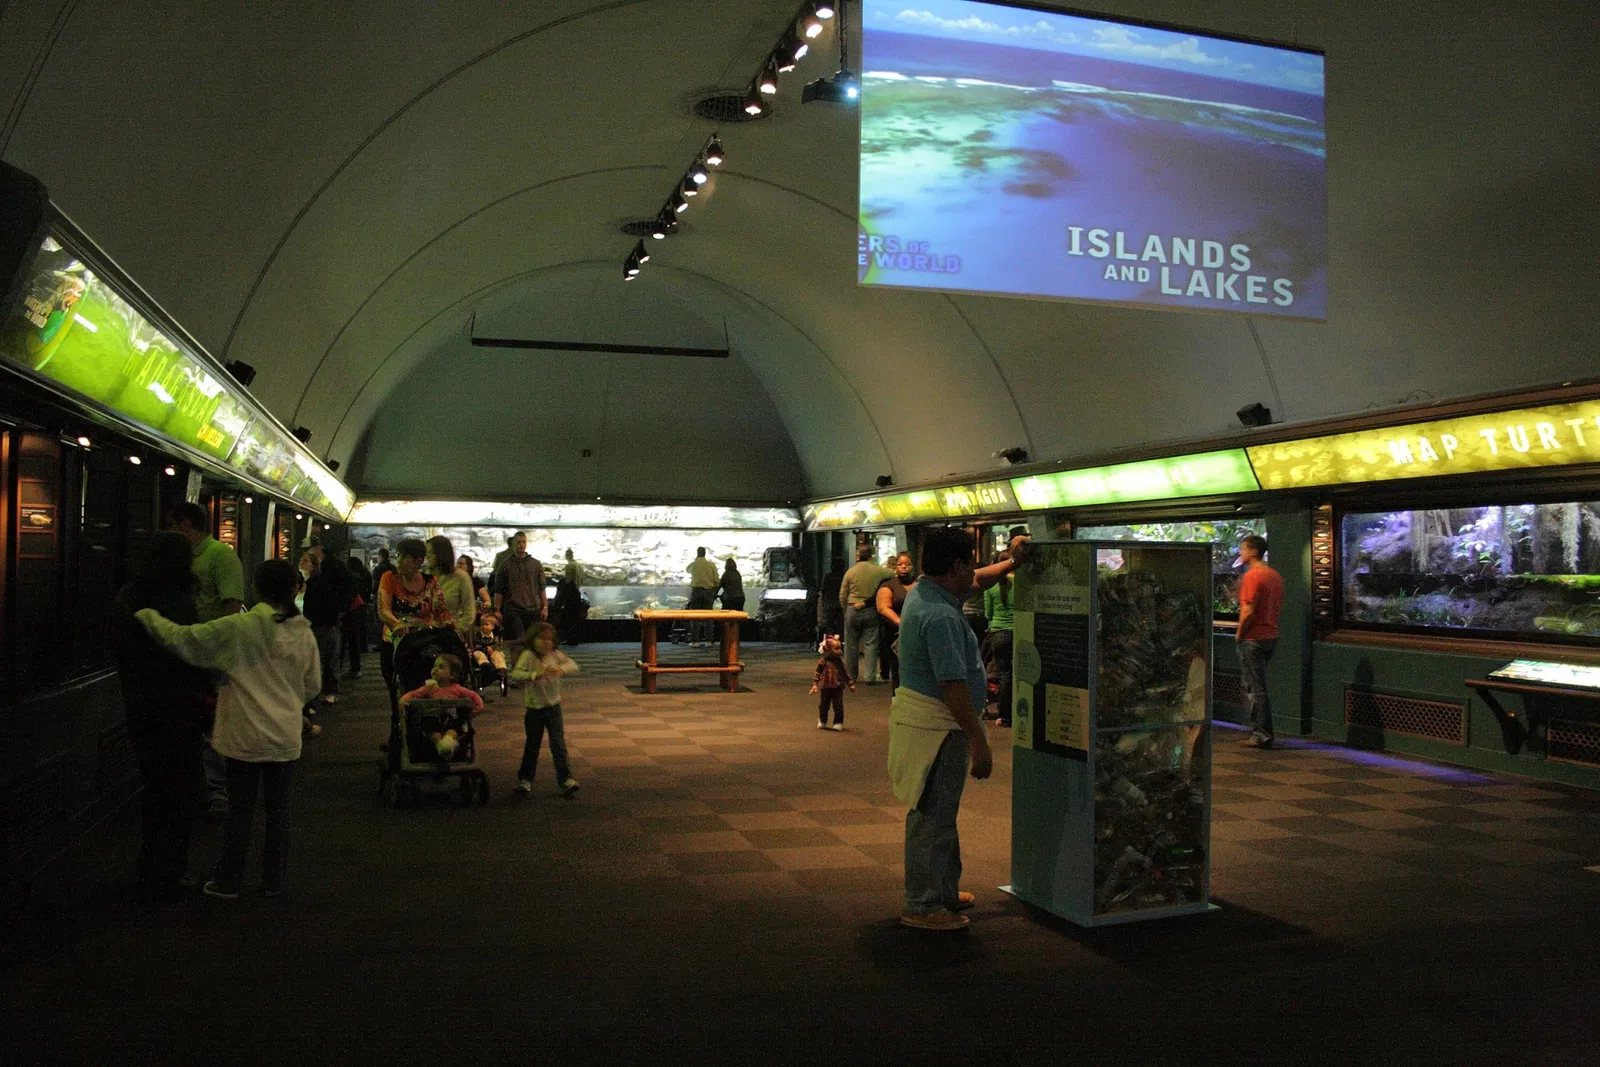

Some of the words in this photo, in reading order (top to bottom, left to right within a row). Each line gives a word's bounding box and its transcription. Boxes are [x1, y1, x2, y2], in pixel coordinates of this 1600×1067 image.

[875, 252, 961, 273] WORLD
[909, 240, 931, 253] OF
[1067, 226, 1251, 272] ISLANDS
[1104, 264, 1150, 282] AND
[1161, 266, 1294, 306] LAKES
[1388, 434, 1458, 465] MAP
[1480, 415, 1600, 456] TURT
